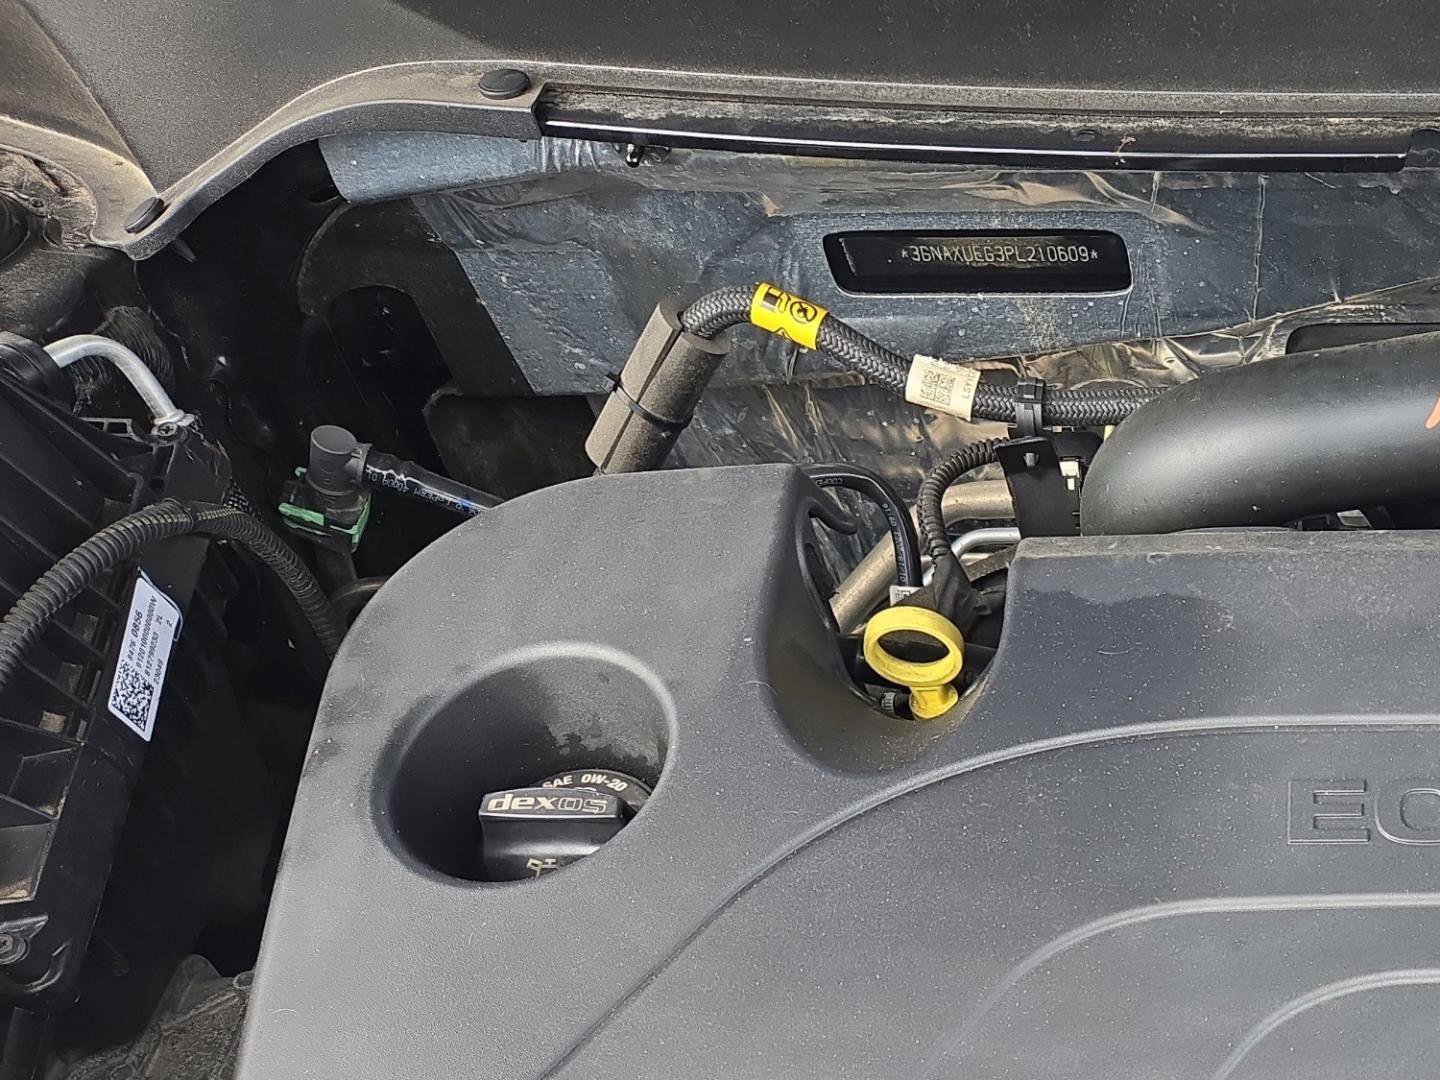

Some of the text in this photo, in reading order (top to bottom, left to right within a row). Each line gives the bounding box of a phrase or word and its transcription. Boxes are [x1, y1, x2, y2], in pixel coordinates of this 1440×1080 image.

[131, 610, 143, 639] 0856
[542, 773, 628, 792] SAE 0W-20
[487, 794, 608, 814] dexos
